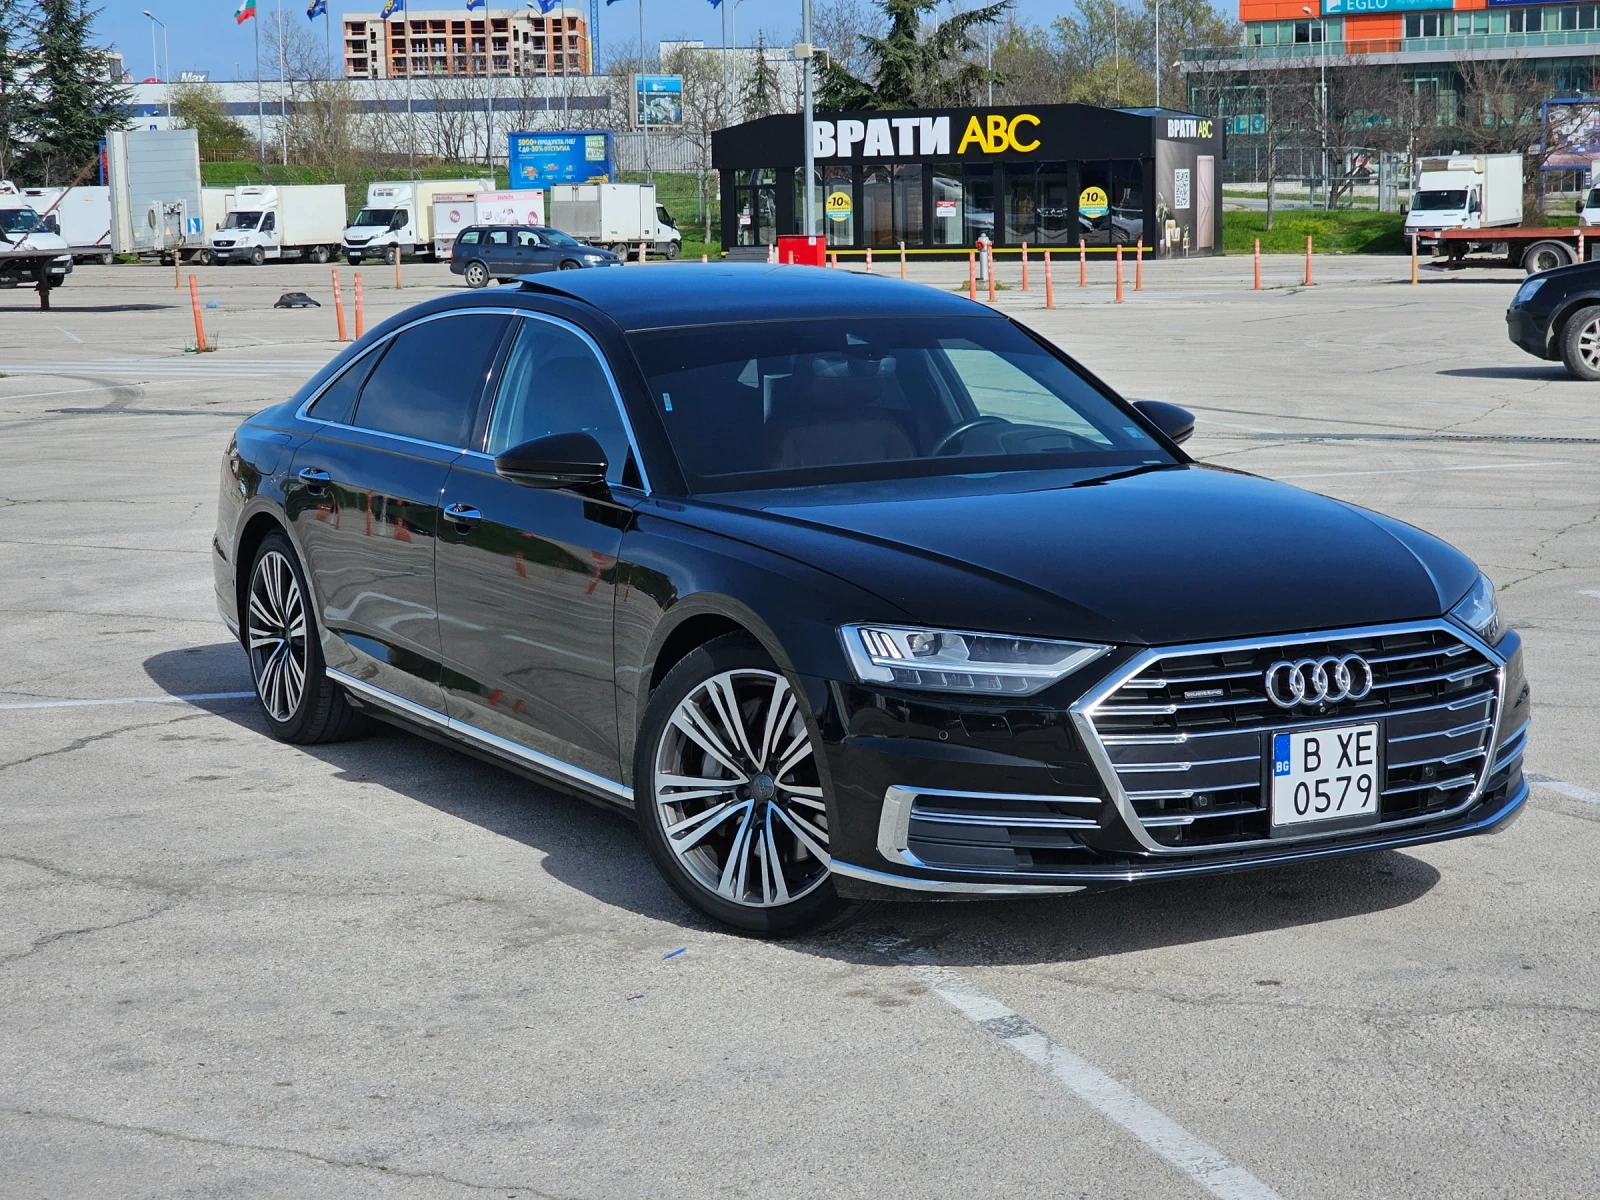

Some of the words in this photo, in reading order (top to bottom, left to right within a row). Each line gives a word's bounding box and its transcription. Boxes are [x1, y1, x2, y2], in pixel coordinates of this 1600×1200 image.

[1347, 0, 1388, 10] EGLO
[181, 71, 206, 82] Max
[1167, 119, 1196, 138] ВРАТИ
[1197, 120, 1213, 138] ABC
[813, 116, 951, 158] ВРАТИ
[957, 114, 1041, 154] ABC
[828, 196, 850, 206] -10%
[1081, 192, 1105, 202] -10%
[1186, 689, 1222, 698] quattro
[1304, 737, 1322, 773] B
[1336, 730, 1373, 769] XE
[1276, 760, 1290, 773] BG
[1294, 773, 1372, 816] 0579
